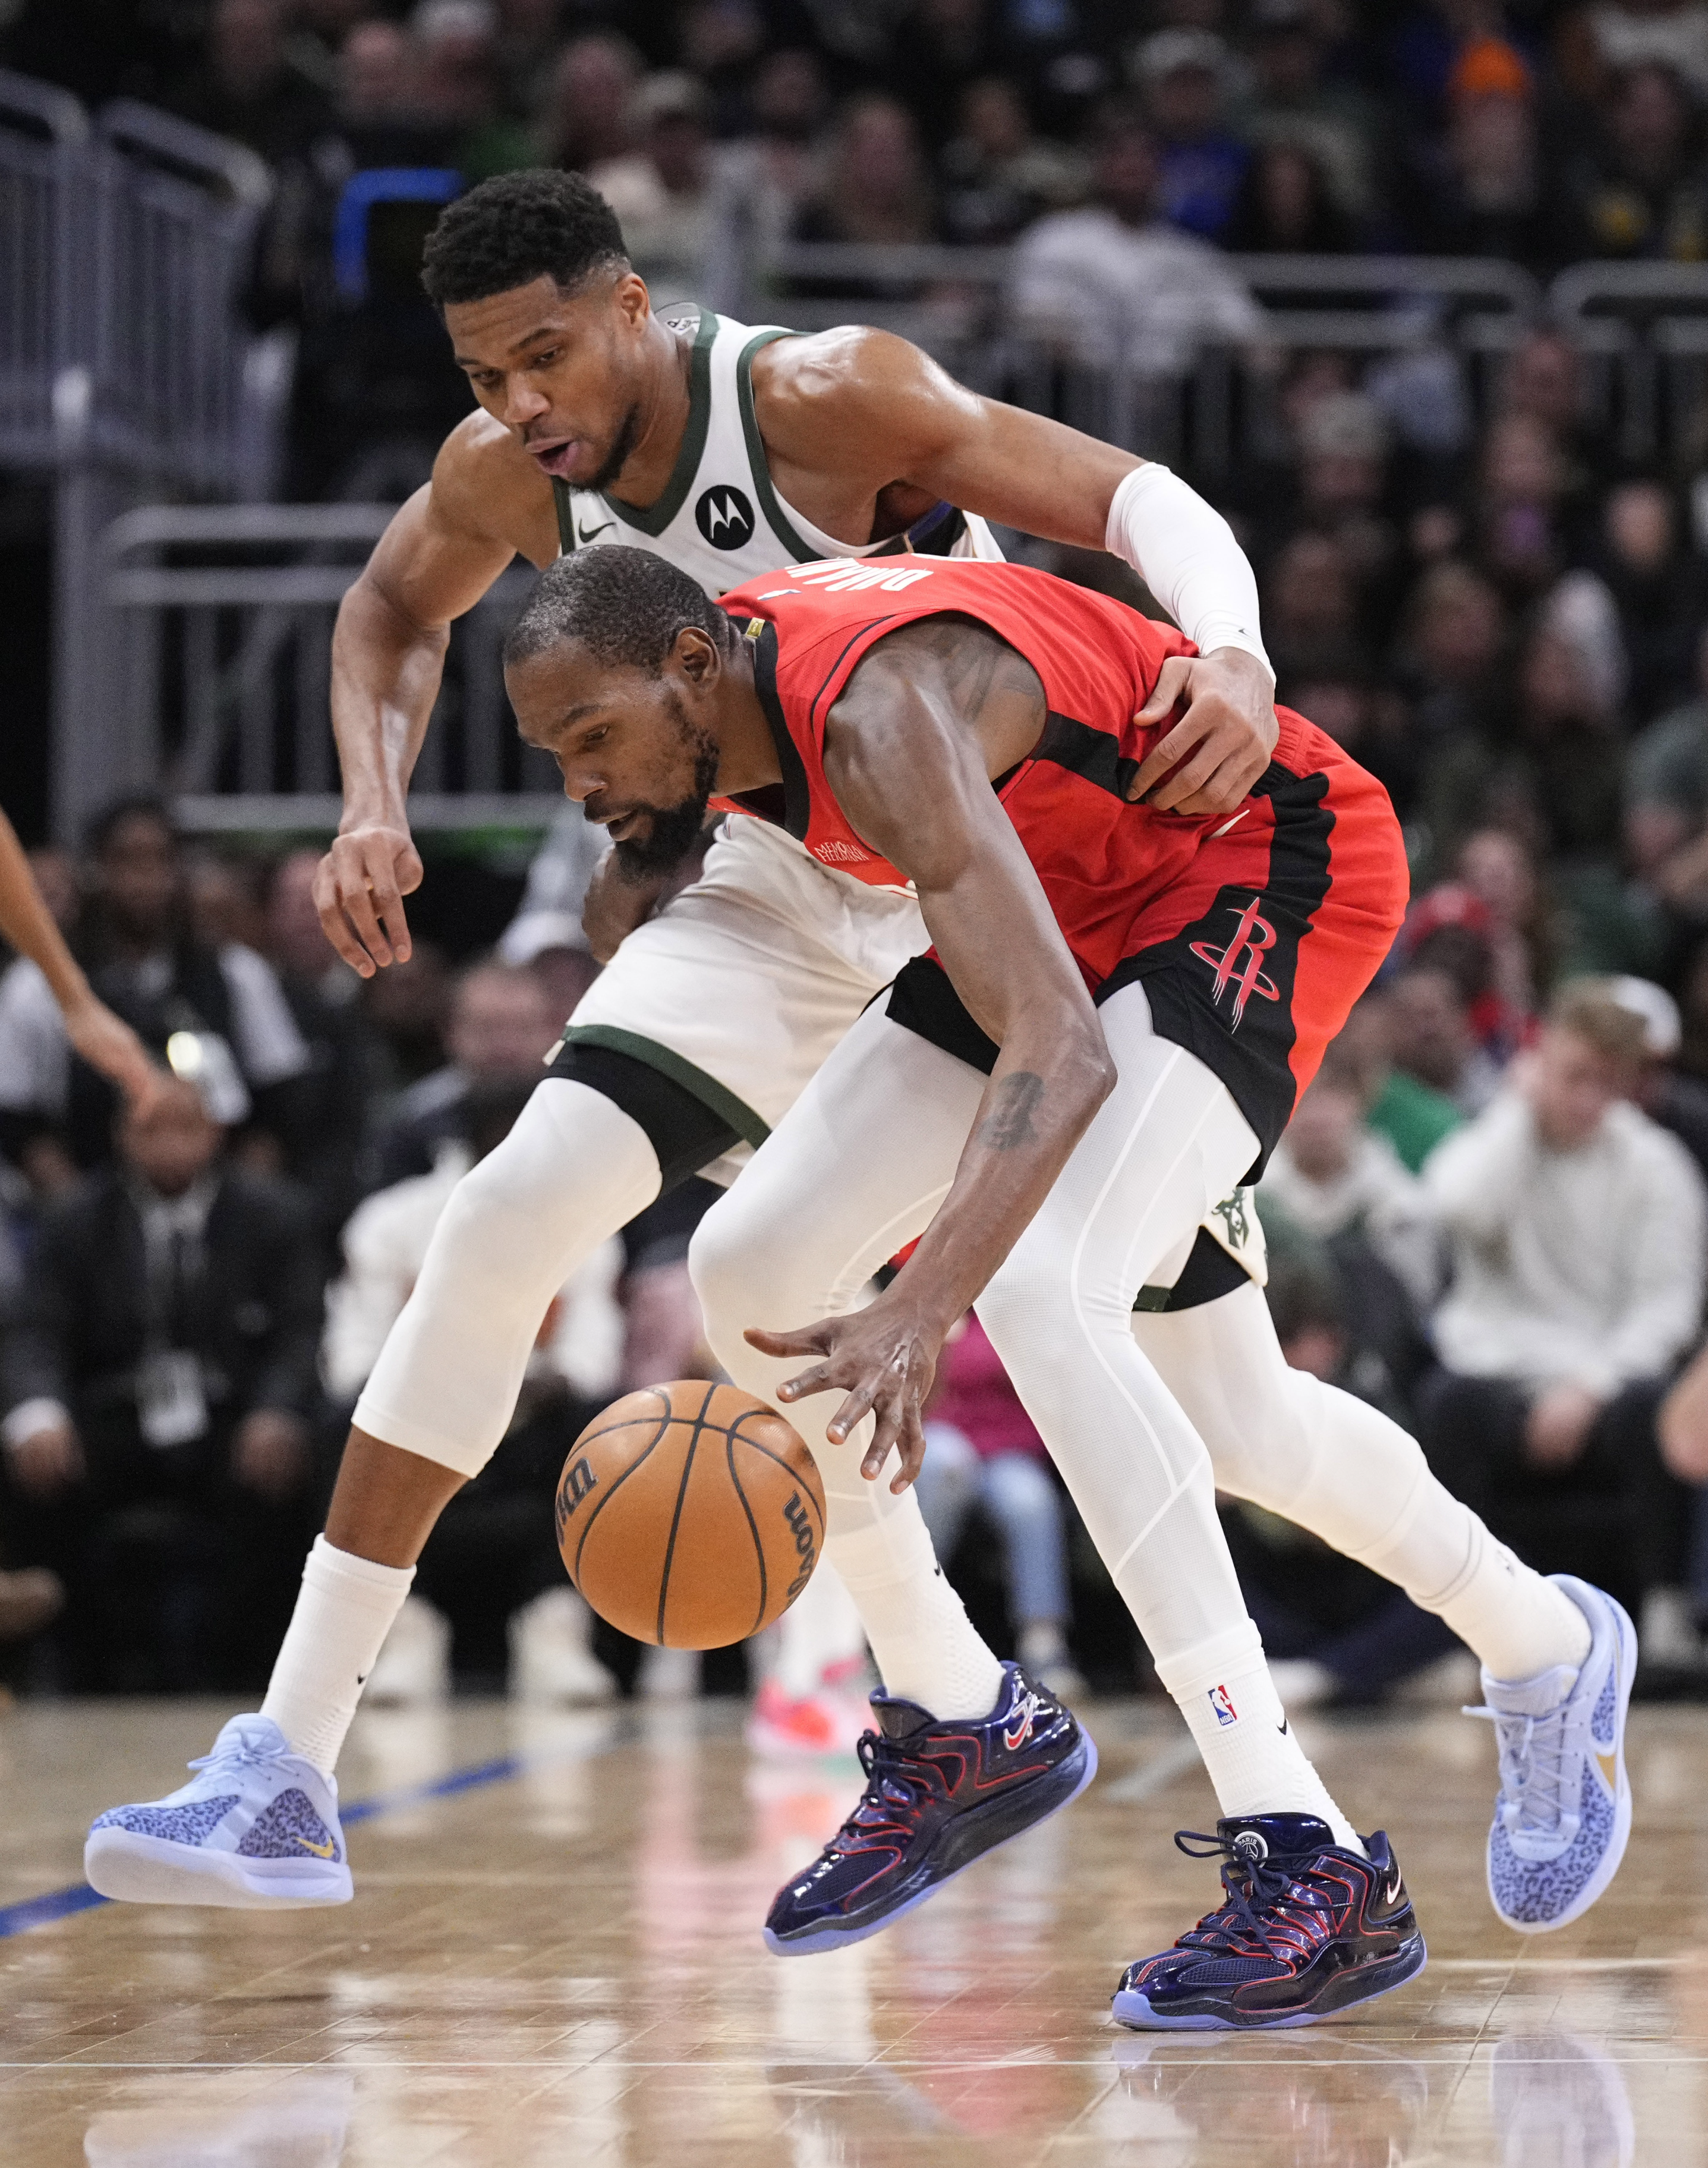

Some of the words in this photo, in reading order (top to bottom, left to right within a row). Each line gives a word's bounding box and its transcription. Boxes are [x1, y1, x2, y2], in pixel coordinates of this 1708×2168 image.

[784, 557, 934, 591] DURAN
[818, 850, 870, 862] HERMANN
[1219, 1713, 1234, 1725] NBA
